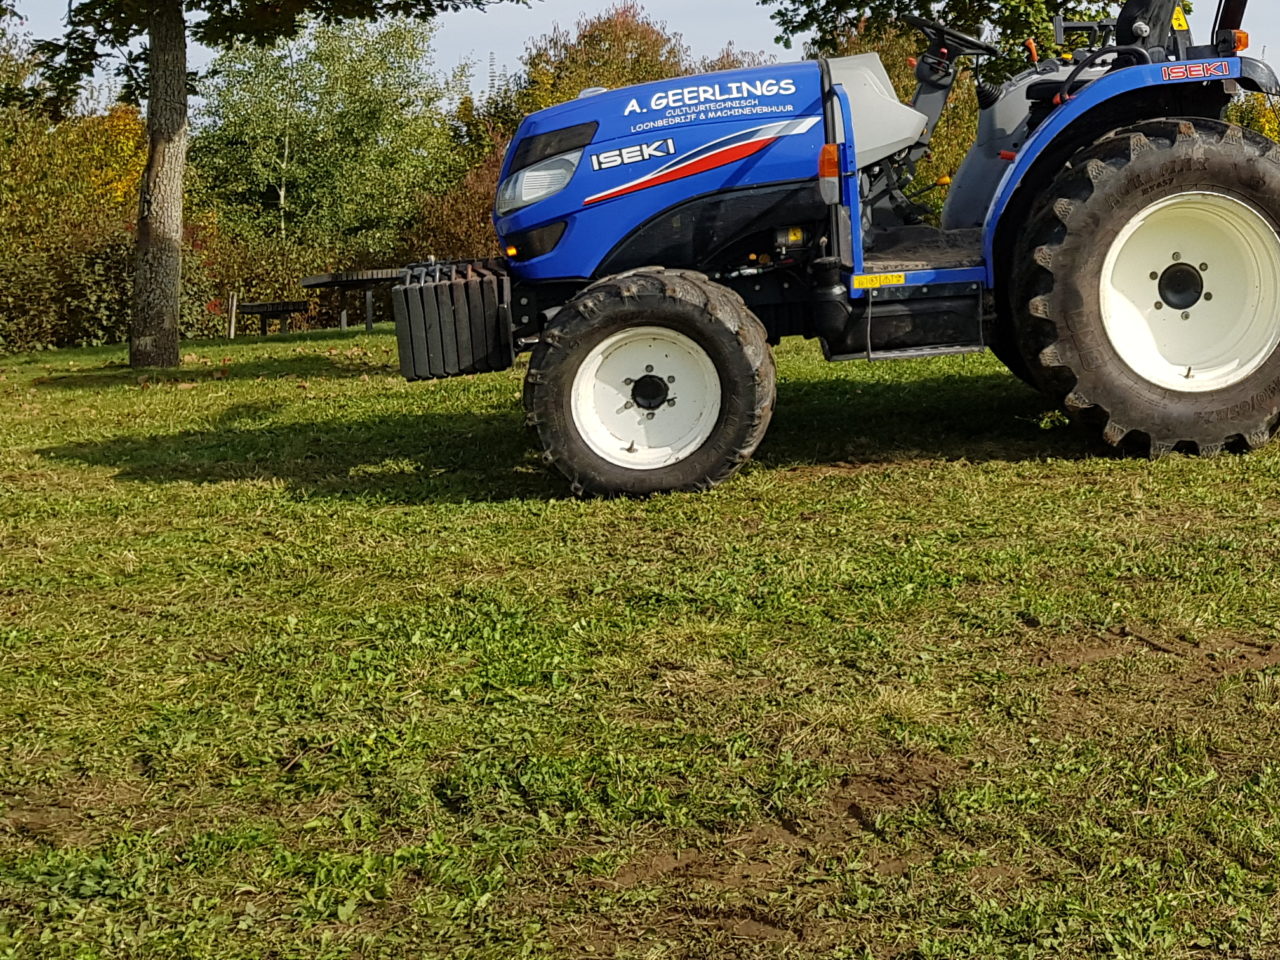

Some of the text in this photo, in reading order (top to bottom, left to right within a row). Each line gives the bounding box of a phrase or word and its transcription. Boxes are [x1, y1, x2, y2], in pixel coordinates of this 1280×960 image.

[1161, 60, 1229, 81] ISEKI
[623, 79, 796, 116] A. GEERLINGS
[665, 98, 759, 117] CULTUURTECHNISCH
[630, 104, 794, 133] LOONBEDRIJF & MACHINEVERHUUR
[590, 138, 677, 172] ISEKI
